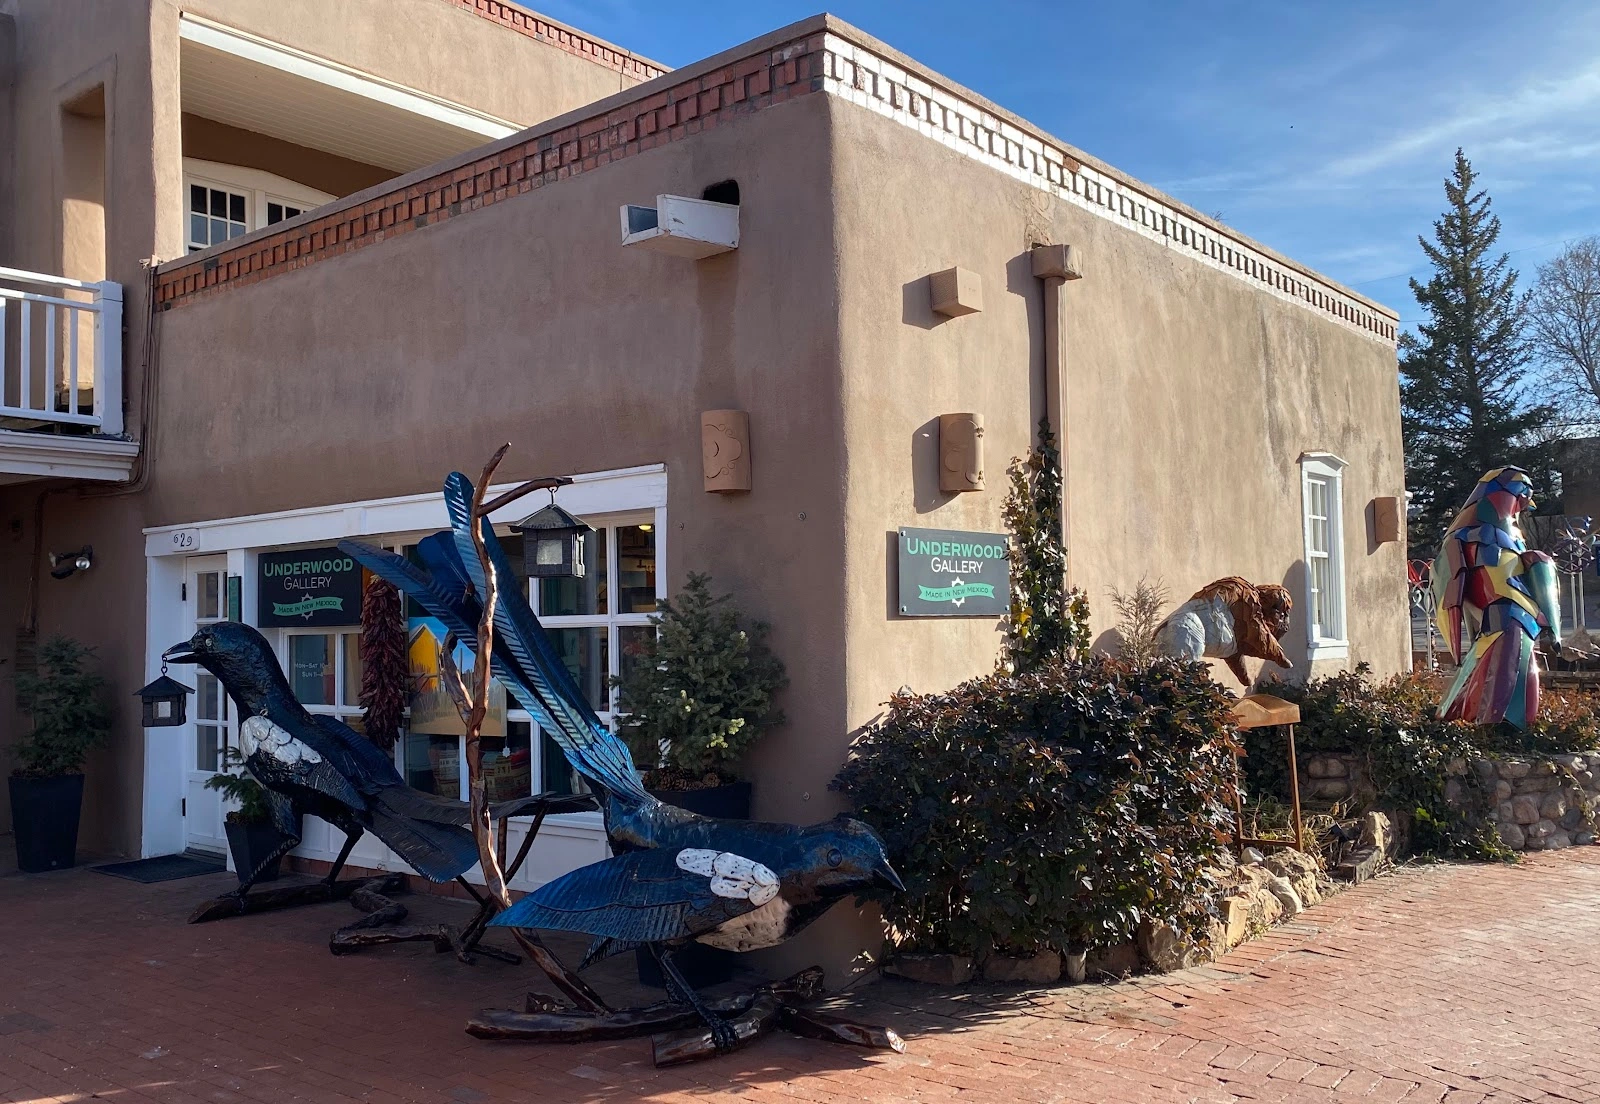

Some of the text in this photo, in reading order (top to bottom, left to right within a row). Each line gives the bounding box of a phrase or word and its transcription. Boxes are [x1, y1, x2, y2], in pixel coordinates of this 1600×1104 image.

[173, 532, 193, 547] 629
[907, 538, 1003, 558] UNDERWOOD
[264, 558, 354, 577] UNDERWOOD
[931, 557, 984, 574] GALLERY
[283, 576, 332, 590] GALLERY
[925, 590, 943, 599] MADE
[952, 589, 965, 598] NEW
[966, 586, 989, 594] MEXICO
[278, 606, 294, 614] MADE
[315, 599, 337, 607] MEXICO
